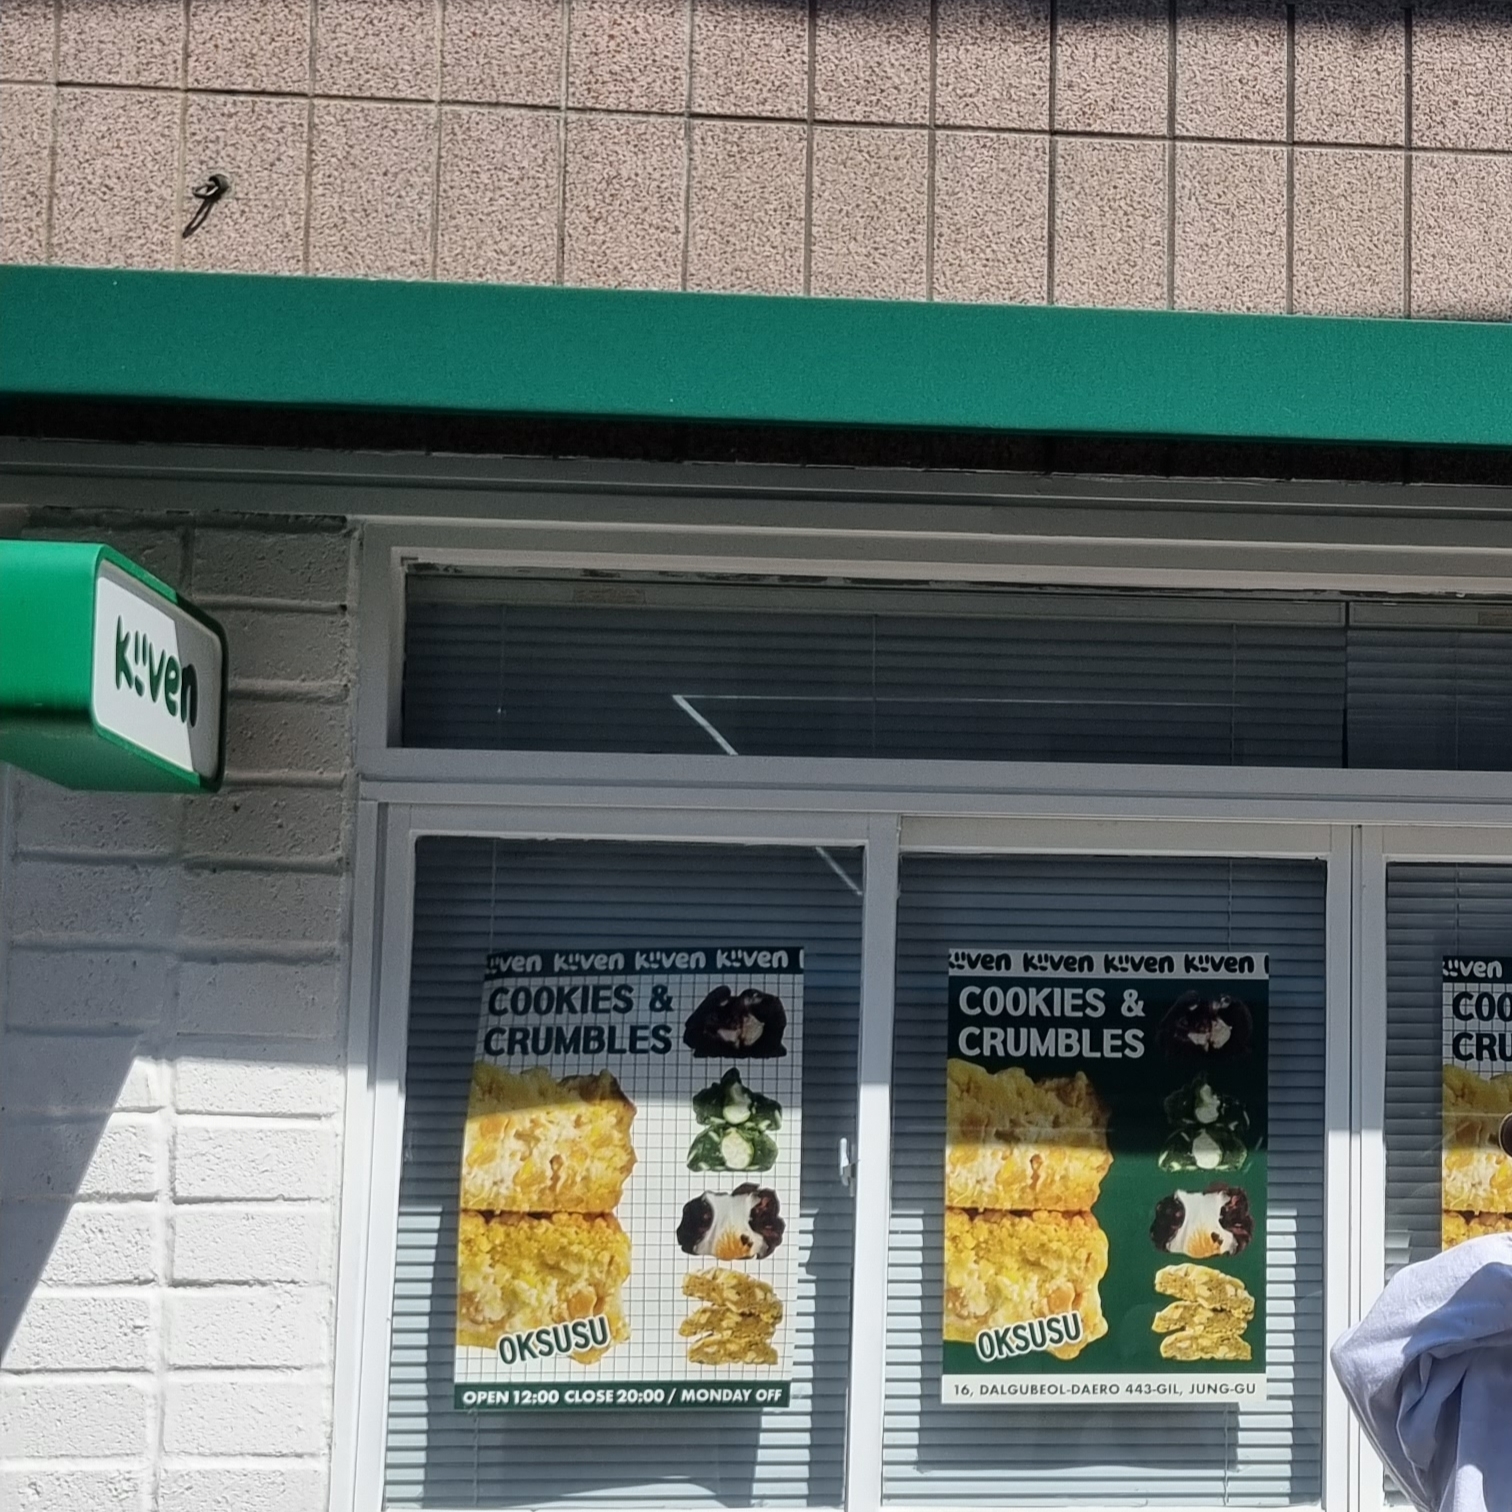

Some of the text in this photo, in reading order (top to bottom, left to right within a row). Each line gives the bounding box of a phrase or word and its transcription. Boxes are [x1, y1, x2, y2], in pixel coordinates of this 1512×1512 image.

[488, 983, 674, 1017] COOKIES &
[959, 986, 1145, 1017] COOKIES &
[484, 1024, 672, 1056] CRUMBLES
[958, 1027, 1145, 1058] CRUMBLES
[500, 1316, 608, 1364] OKSUSU
[978, 1312, 1081, 1360] OKSUSU
[463, 1388, 782, 1405] OPEN 12:00 CLOSE 20:00 / MONDAY OFF
[954, 1382, 1256, 1397] 16, DALGUBEOL-DAERO 443-GIL, JUNG-GU
